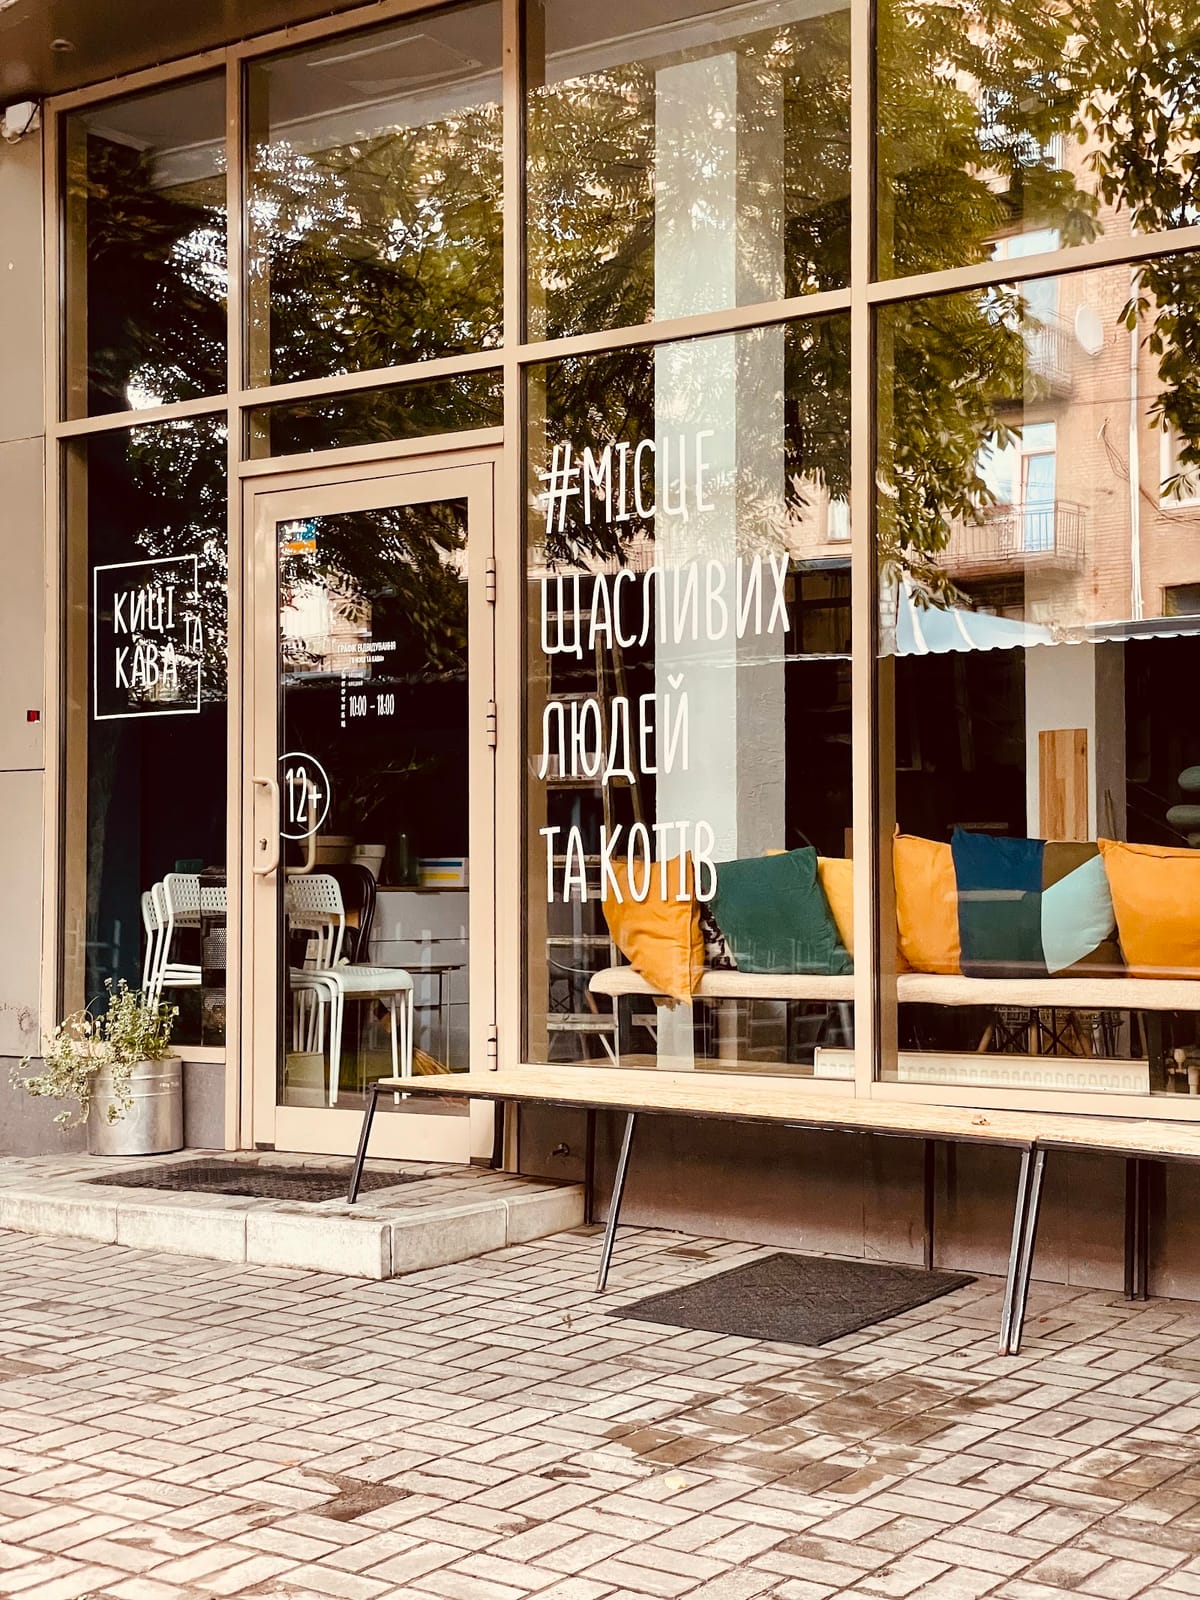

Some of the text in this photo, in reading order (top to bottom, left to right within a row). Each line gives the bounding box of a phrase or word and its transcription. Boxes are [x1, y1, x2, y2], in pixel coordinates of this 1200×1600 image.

[538, 430, 715, 534] #МІСЦЕ
[114, 585, 176, 634] КИЦІ
[182, 612, 204, 653] ТА
[541, 552, 791, 660] ЩАСЛИВИХ
[115, 642, 178, 689] КАВА
[349, 695, 367, 717] 10:00
[538, 672, 690, 786] ЛЮДЕЙ
[285, 766, 322, 823] 12+
[539, 820, 718, 904] ТА КОТІВ
